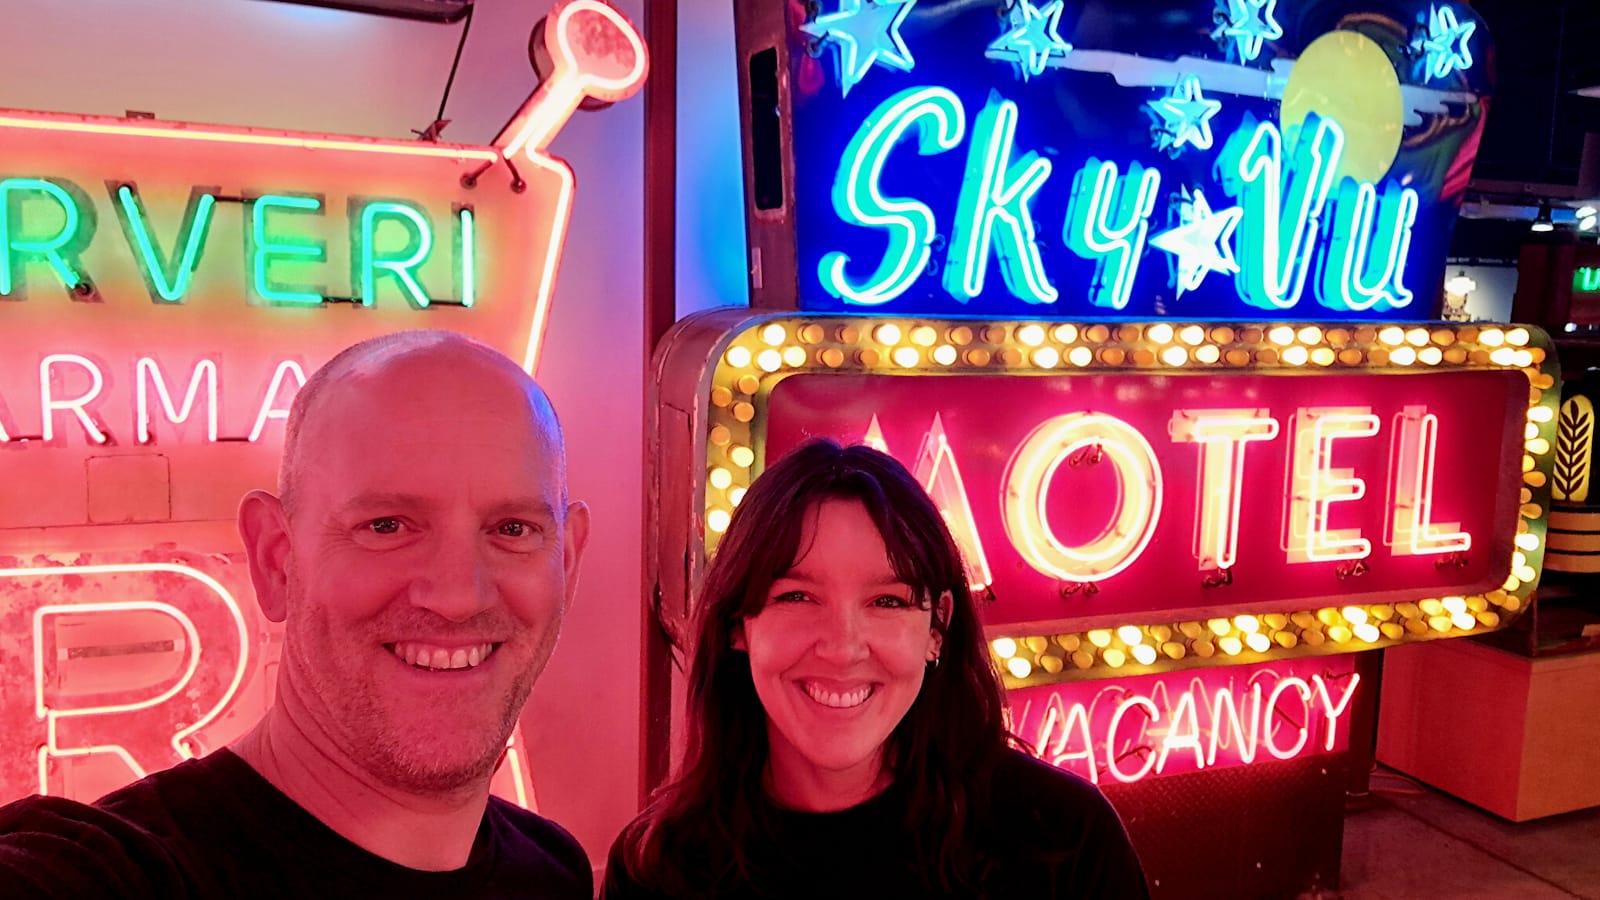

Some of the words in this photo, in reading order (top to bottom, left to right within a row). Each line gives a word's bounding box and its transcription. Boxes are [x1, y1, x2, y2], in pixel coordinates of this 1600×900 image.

[818, 85, 1164, 308] Sky
[1216, 113, 1416, 311] Vu
[0, 353, 310, 444] RMA
